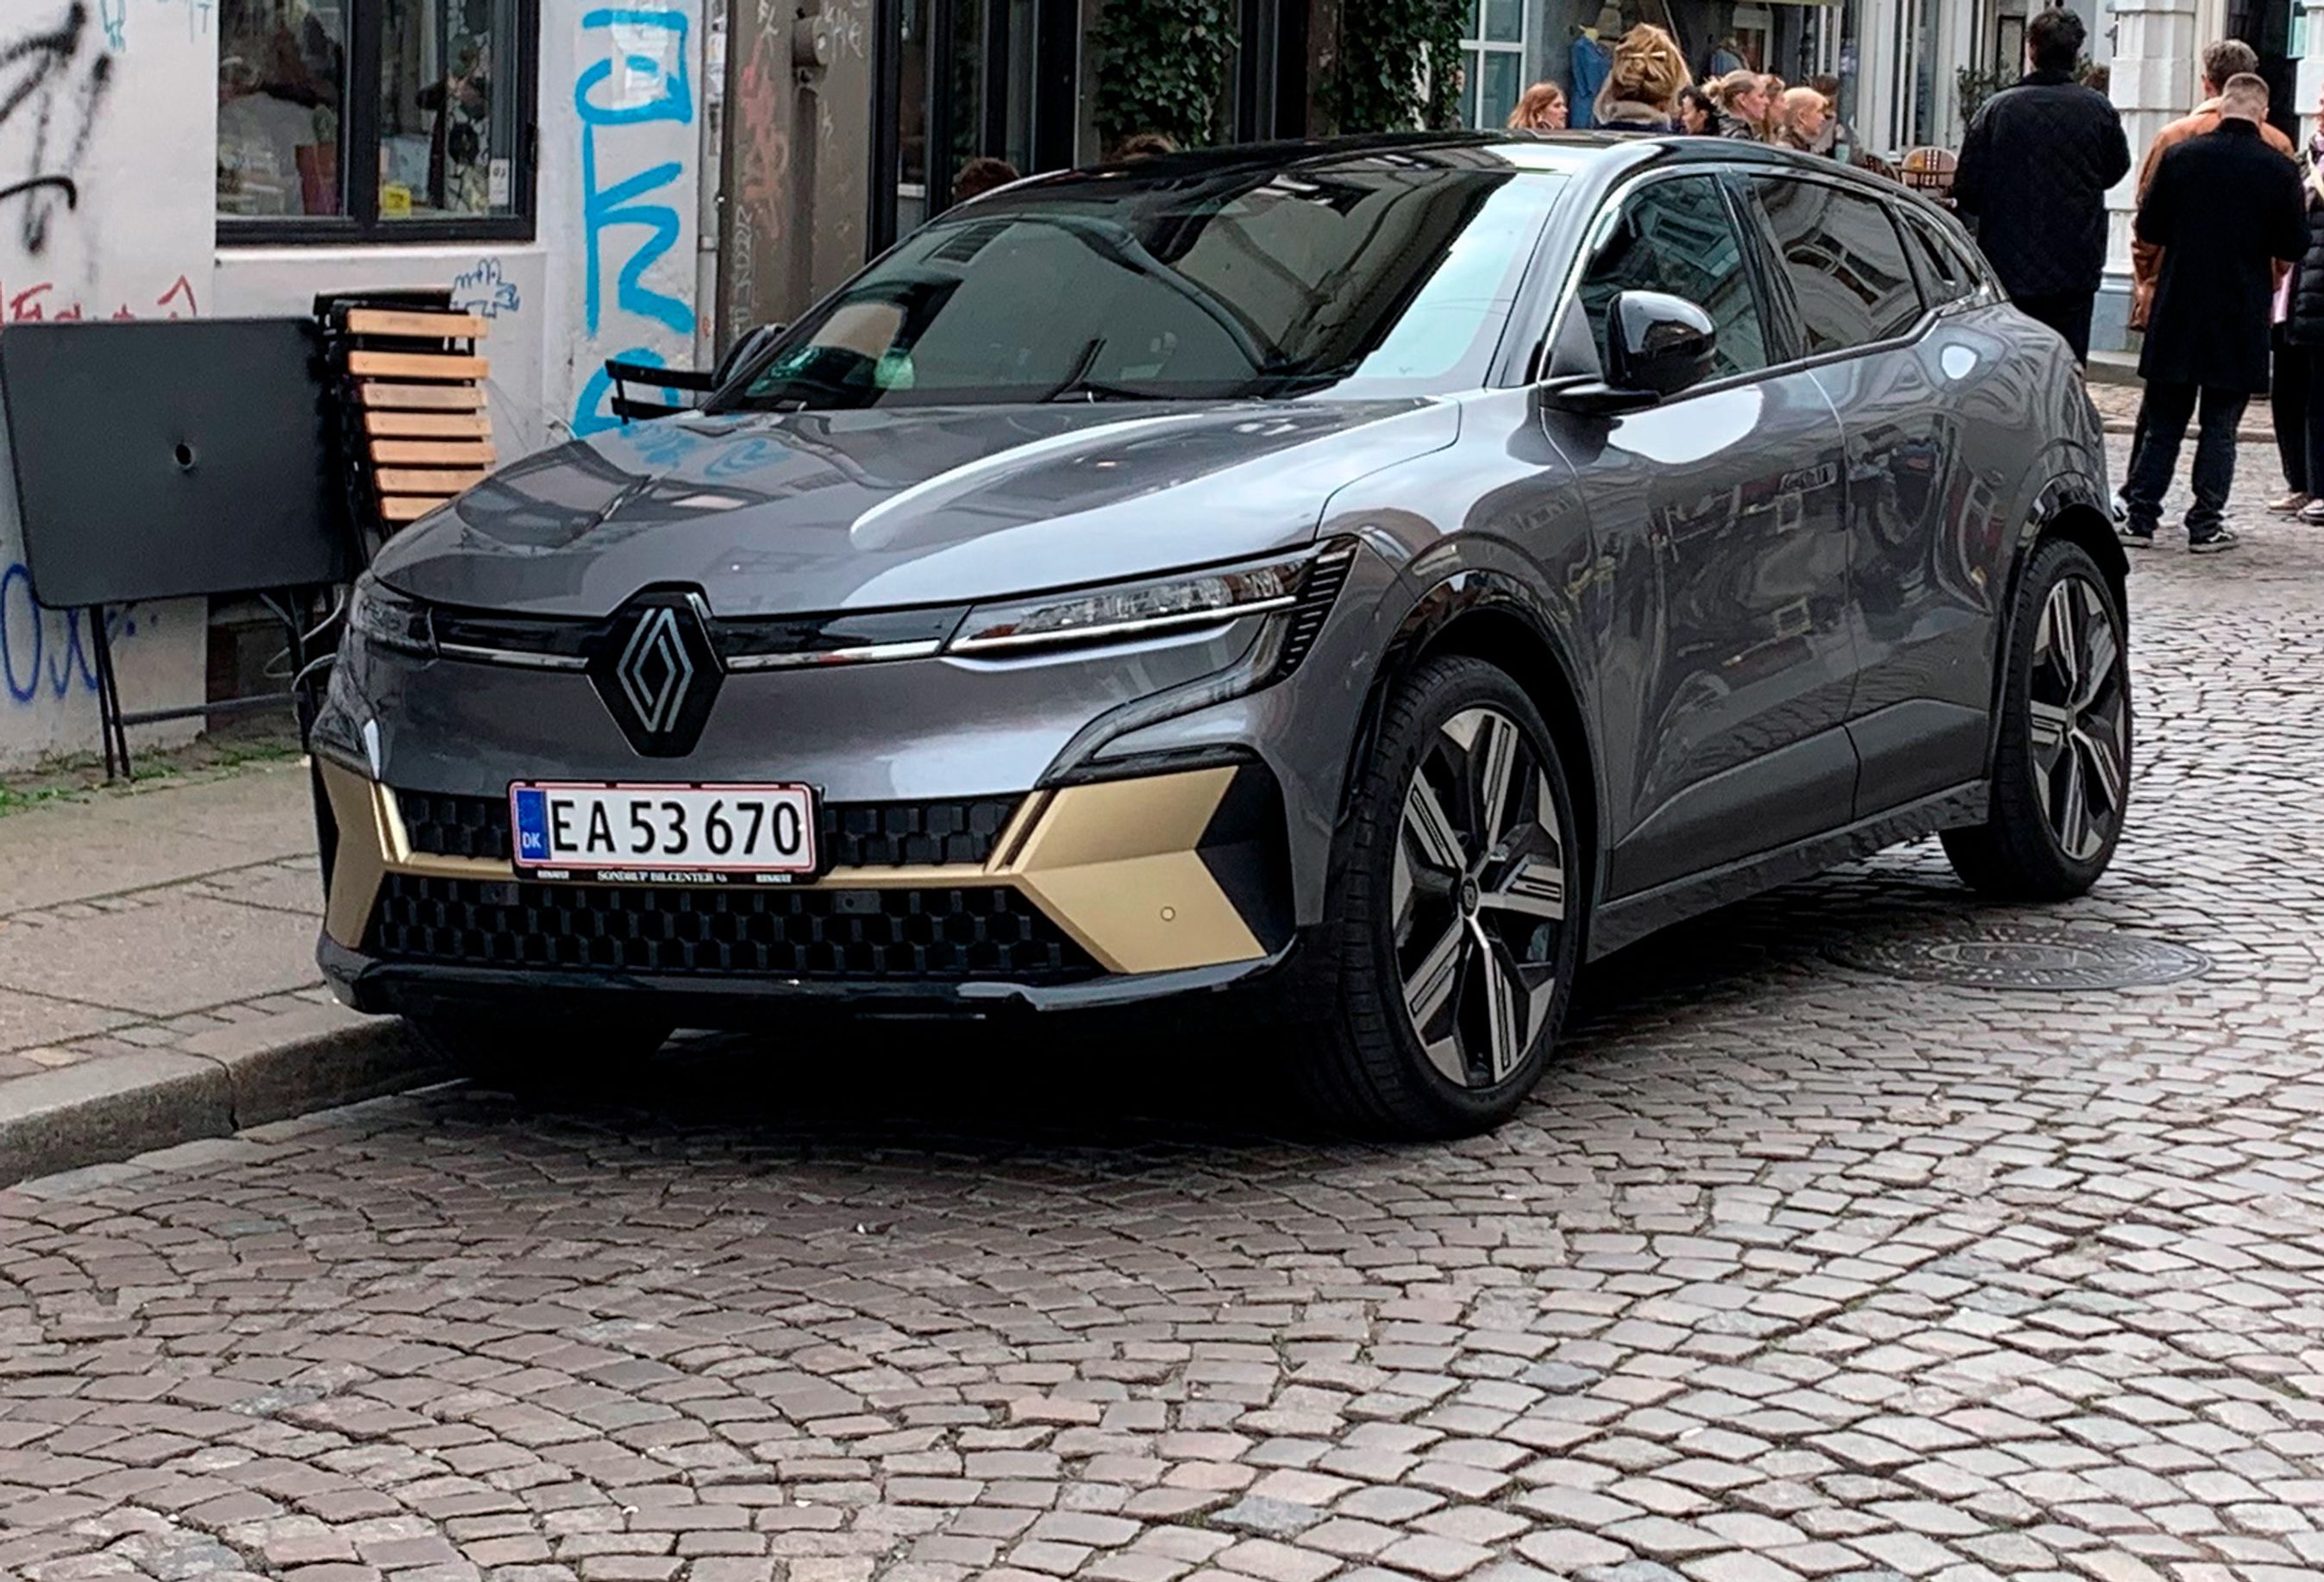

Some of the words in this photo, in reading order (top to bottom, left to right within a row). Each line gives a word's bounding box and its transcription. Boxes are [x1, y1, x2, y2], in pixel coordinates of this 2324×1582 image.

[523, 832, 542, 848] DK
[551, 800, 616, 852] EA
[630, 800, 688, 855] 53
[705, 799, 801, 856] 670
